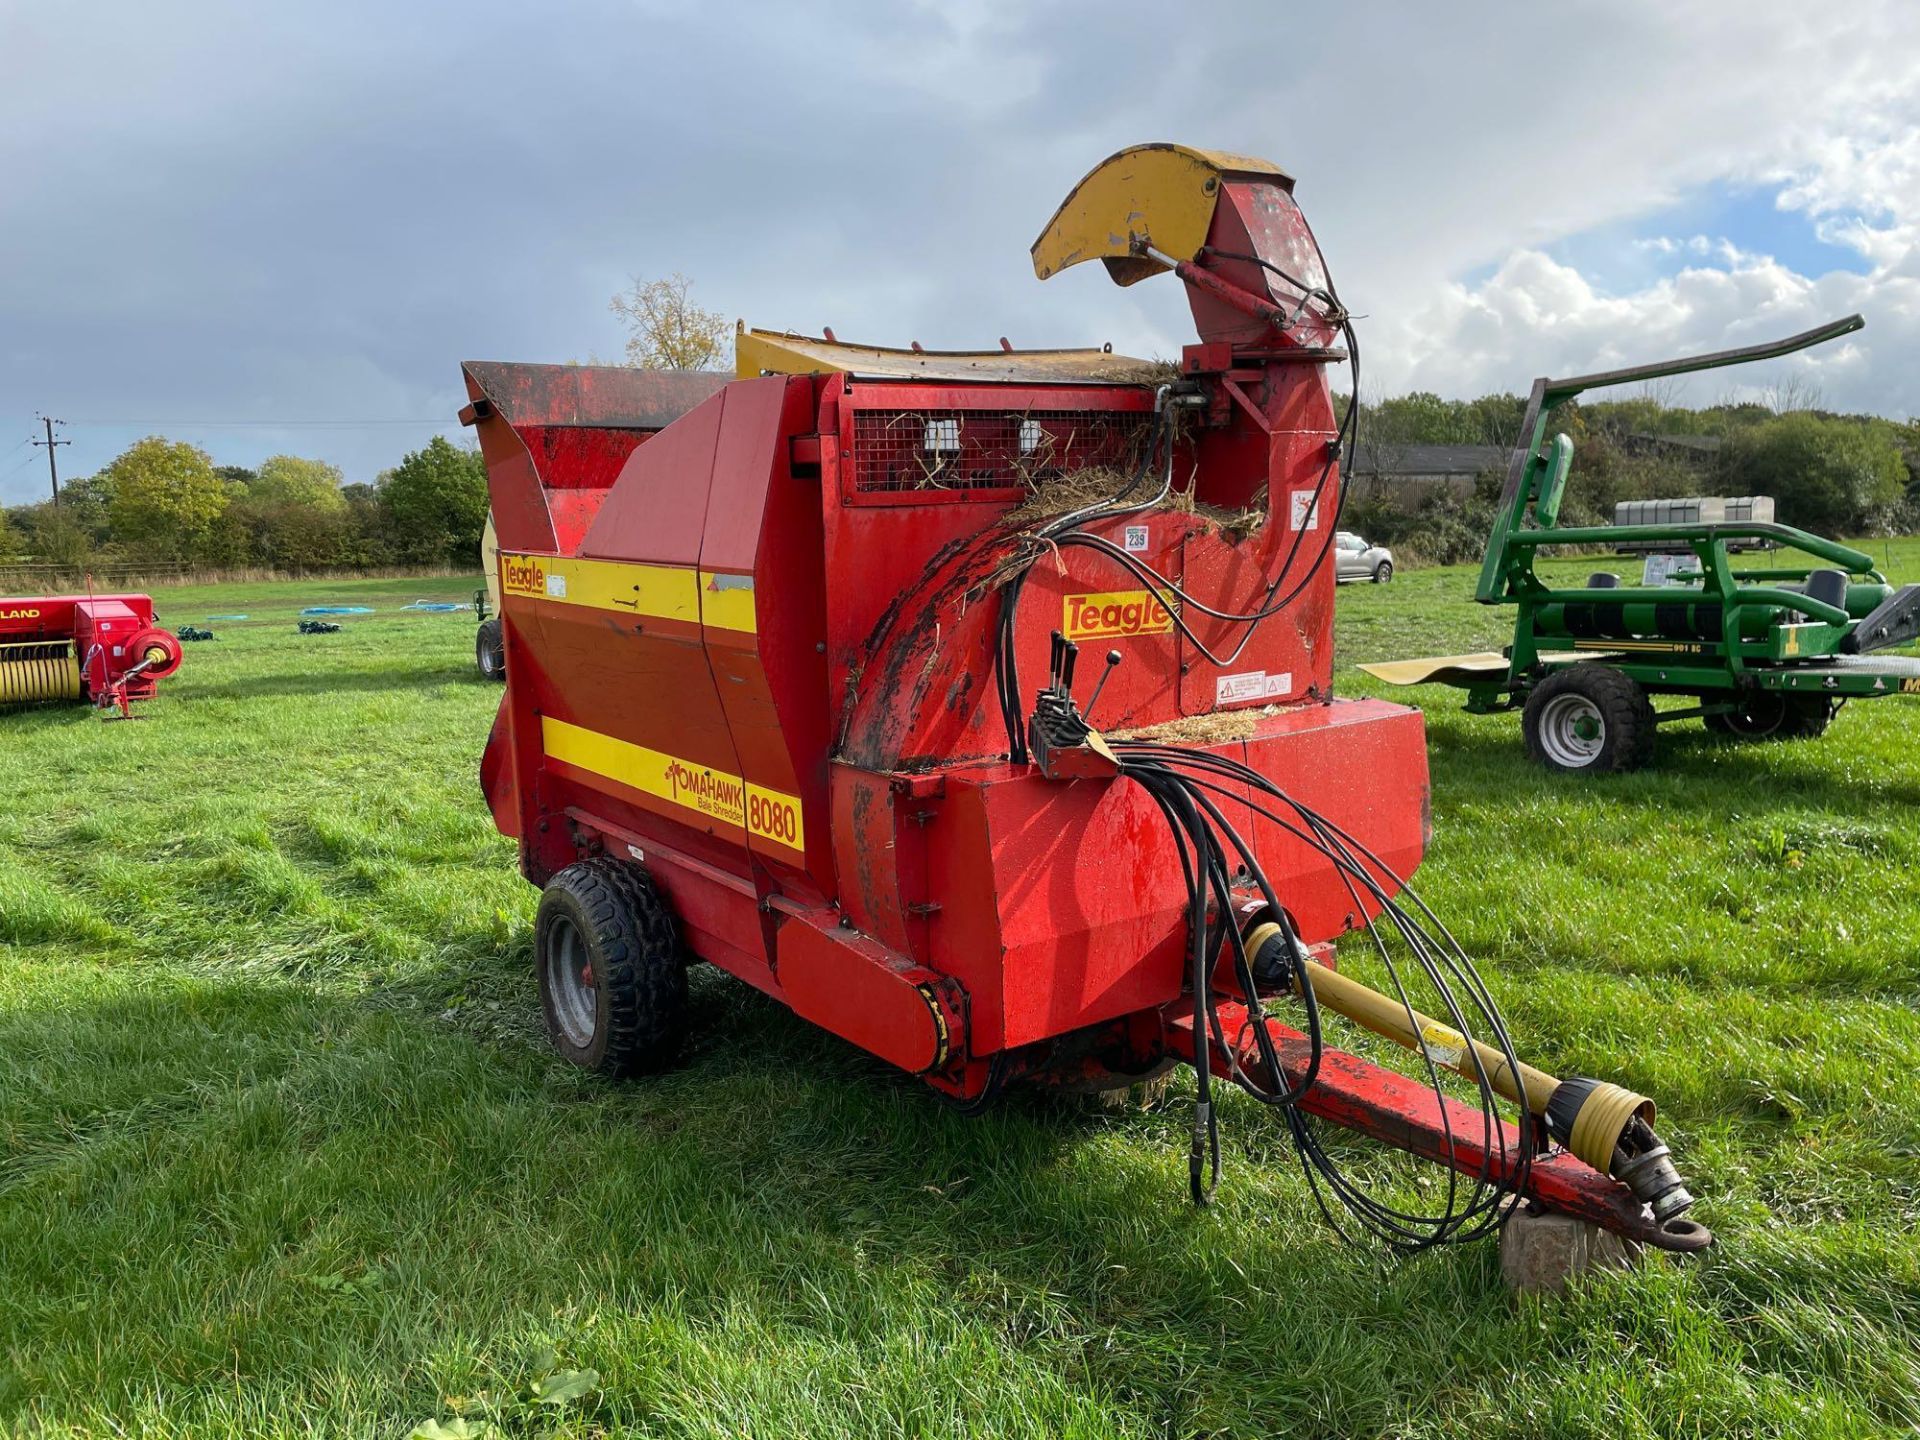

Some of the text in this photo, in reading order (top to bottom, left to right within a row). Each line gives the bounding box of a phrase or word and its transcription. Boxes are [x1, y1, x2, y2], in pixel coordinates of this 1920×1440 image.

[1129, 534, 1145, 546] 239
[504, 558, 543, 592] Teagle
[1068, 593, 1169, 634] Teagle
[664, 760, 796, 843] TOMAHAWK 8080
[697, 796, 743, 822] Bale Shredder
